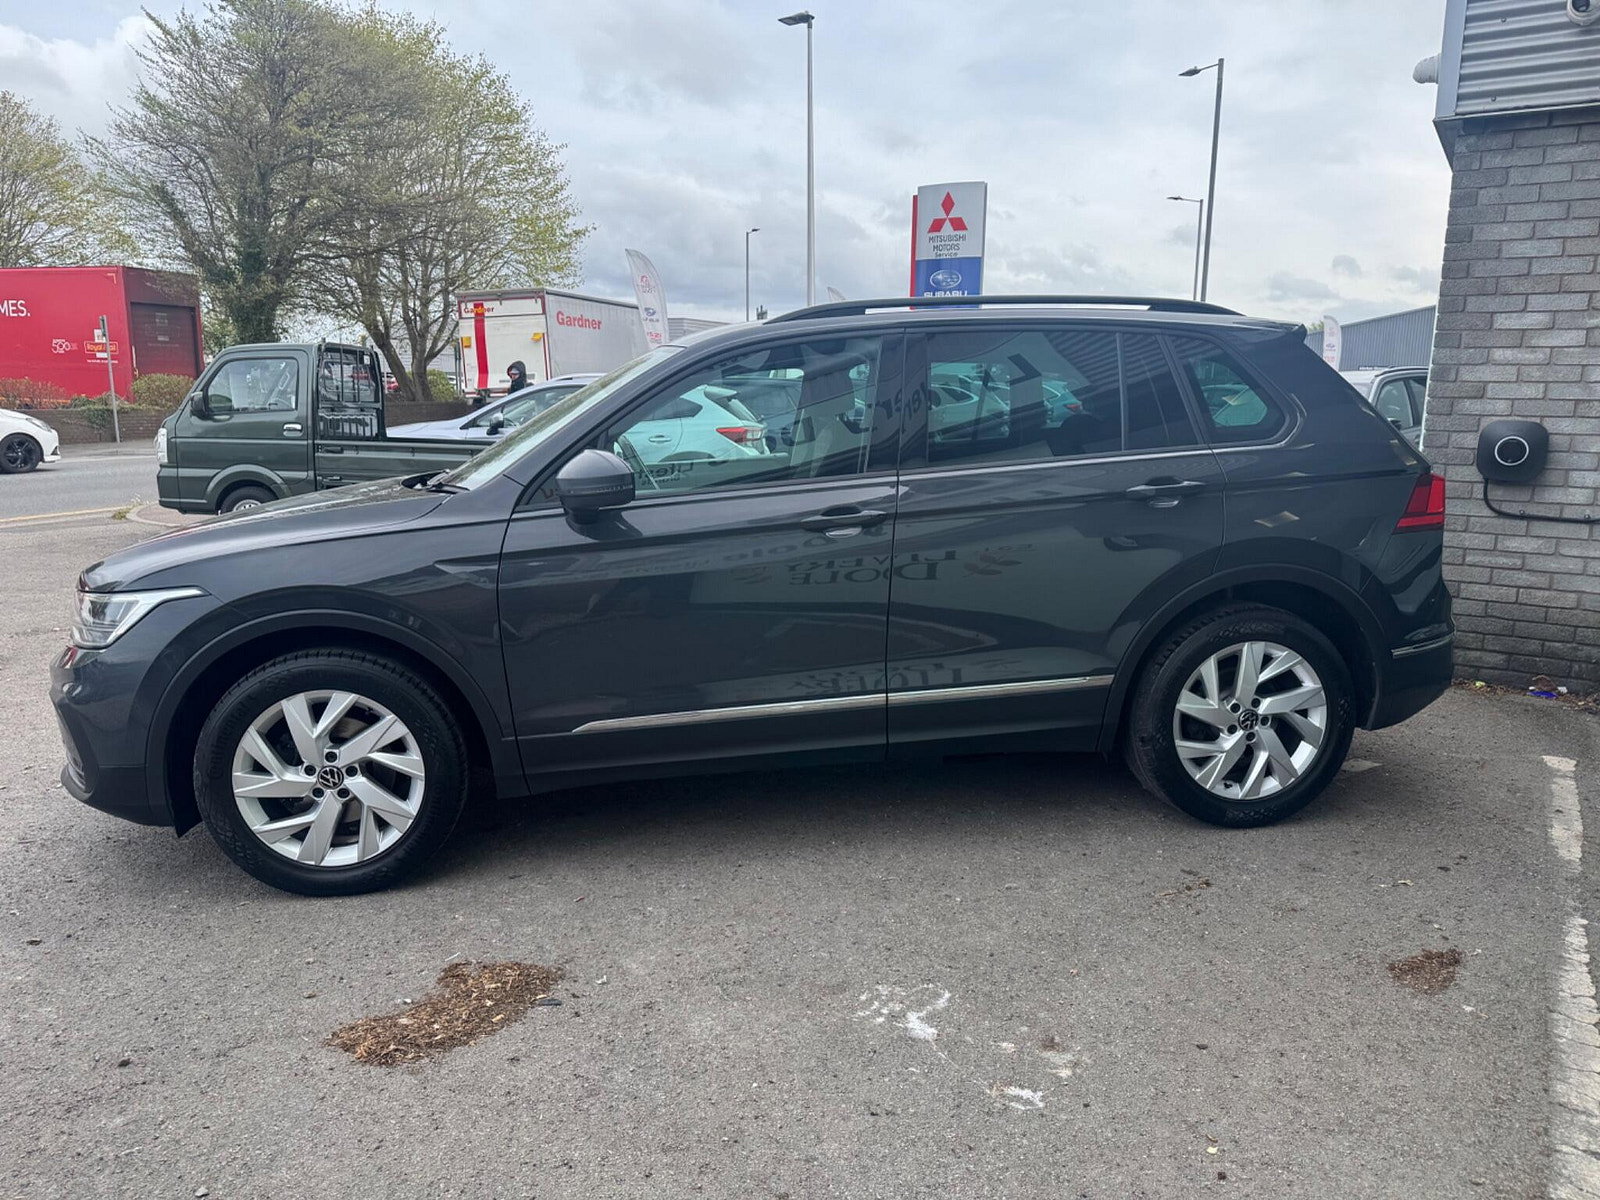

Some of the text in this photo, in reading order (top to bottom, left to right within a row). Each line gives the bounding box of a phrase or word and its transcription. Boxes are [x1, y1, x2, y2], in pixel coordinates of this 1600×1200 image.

[928, 234, 967, 243] MITSUBISHI
[932, 243, 960, 252] MOTORS
[463, 306, 495, 314] Gardner
[556, 311, 602, 330] Gardner
